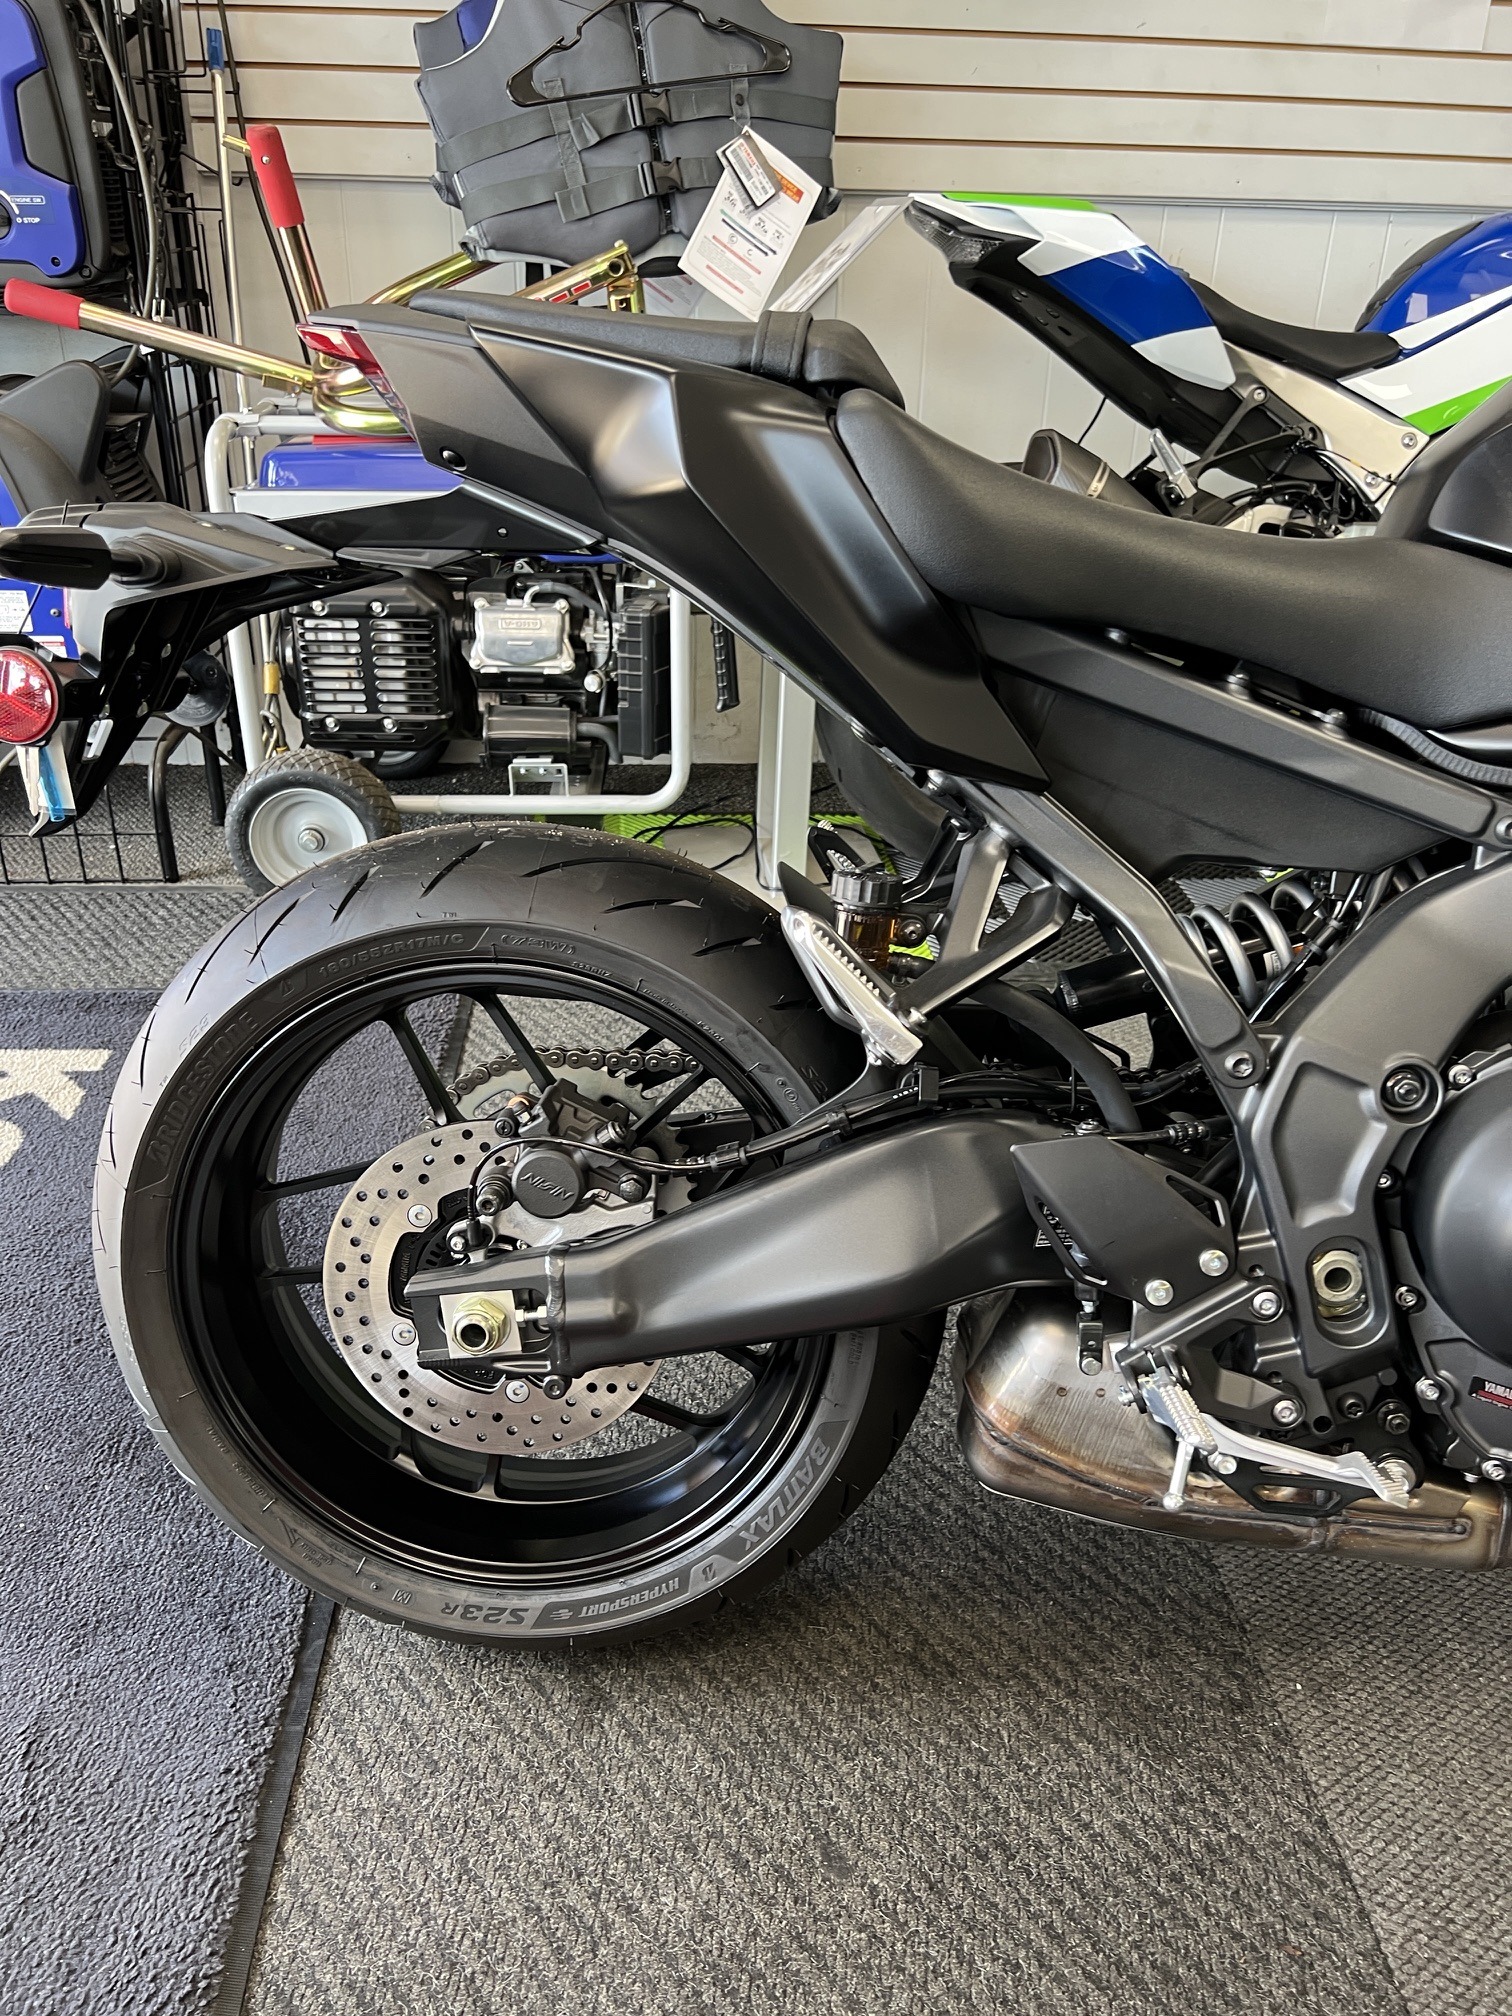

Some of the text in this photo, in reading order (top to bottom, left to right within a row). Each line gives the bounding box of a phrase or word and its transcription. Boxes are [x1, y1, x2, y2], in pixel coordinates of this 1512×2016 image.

[147, 1011, 258, 1167] BRIDGESTONE
[1484, 1380, 1512, 1400] YAMA
[738, 1436, 831, 1551] BATTLAX
[440, 1601, 531, 1625] S23R
[578, 1577, 680, 1619] HYPERSPORT
